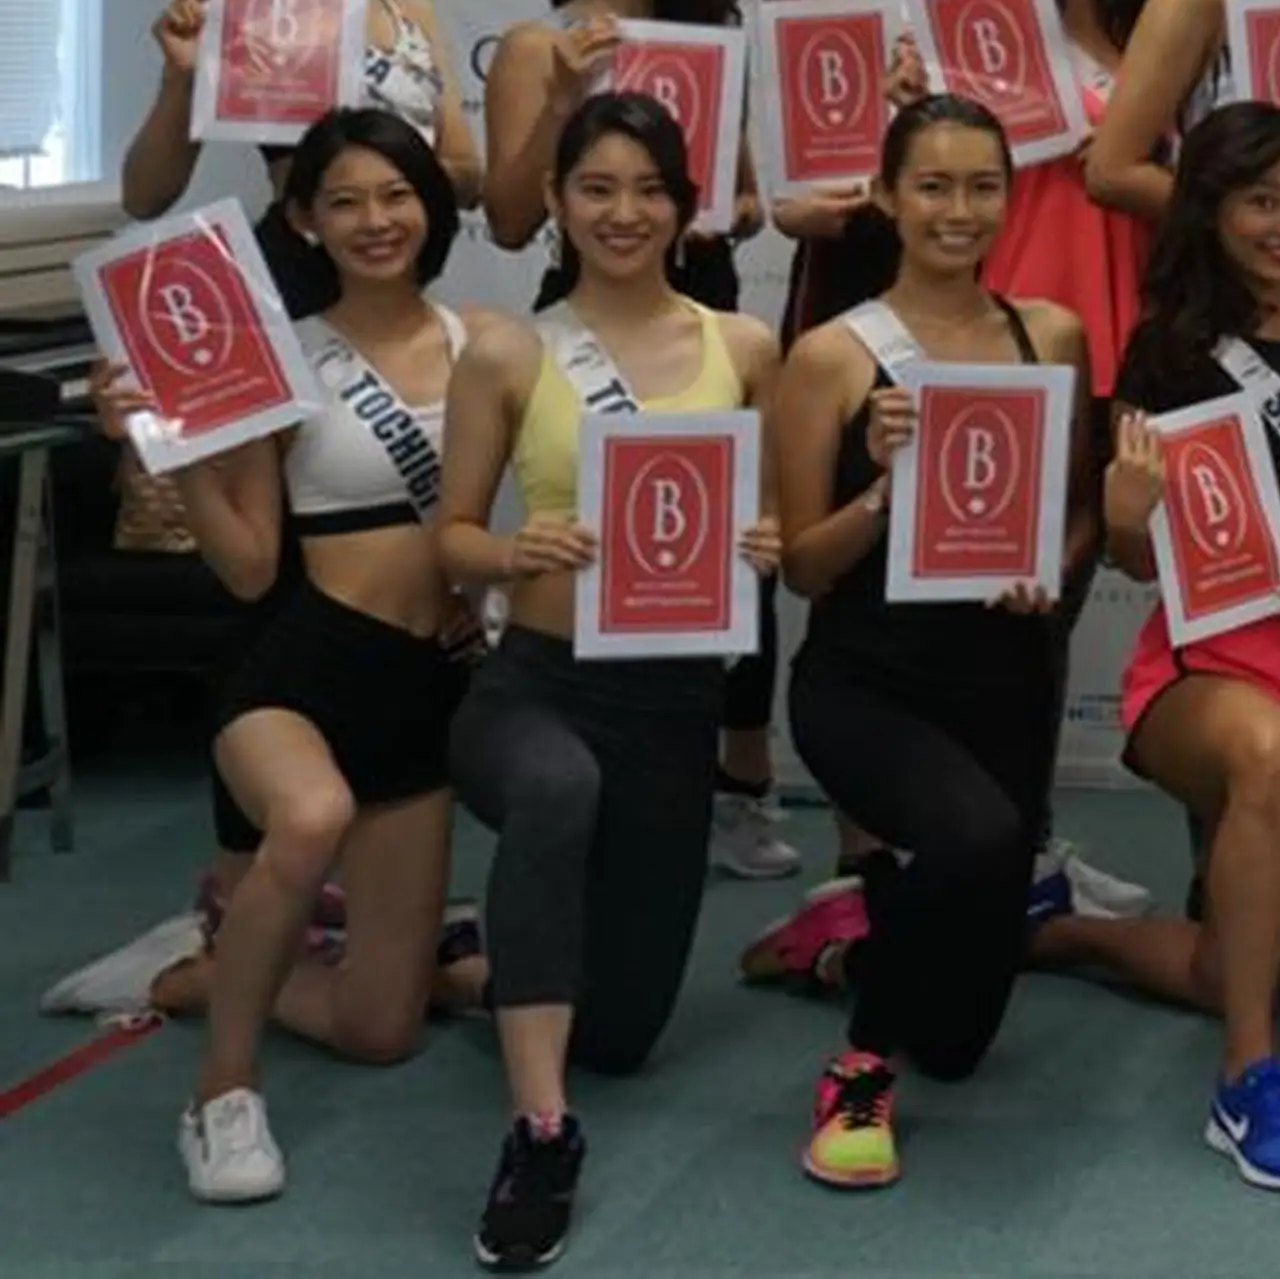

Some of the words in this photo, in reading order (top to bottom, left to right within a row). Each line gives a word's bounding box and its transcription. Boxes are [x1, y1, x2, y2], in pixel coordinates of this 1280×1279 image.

[973, 19, 1008, 73] B
[818, 51, 847, 102] B
[158, 284, 209, 343] B
[967, 427, 996, 489] B
[654, 478, 685, 542] B
[1191, 465, 1228, 525] B
